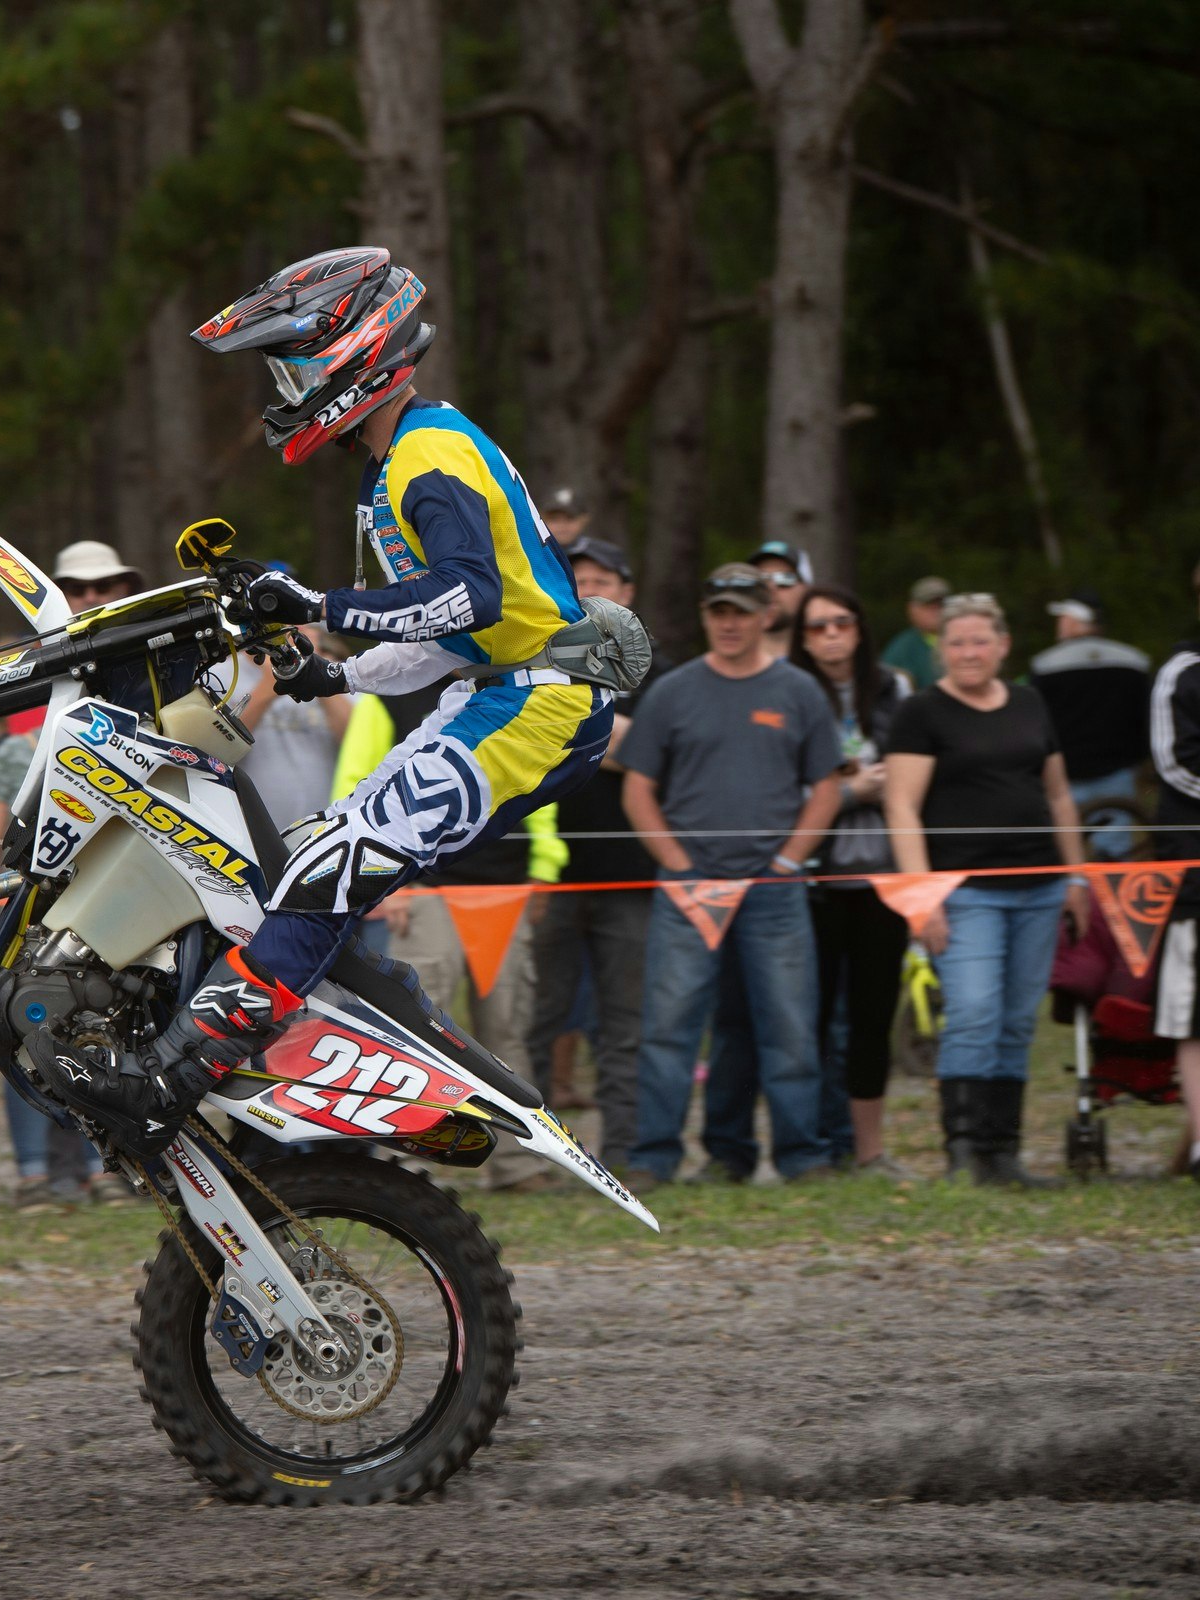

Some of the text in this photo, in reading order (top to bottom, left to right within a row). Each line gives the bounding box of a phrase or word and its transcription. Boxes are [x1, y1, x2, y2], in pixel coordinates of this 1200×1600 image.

[317, 387, 367, 427] 212
[342, 581, 472, 634] MOOSE
[402, 613, 475, 643] RACING
[212, 720, 236, 742] IMS
[170, 749, 198, 763] IMS
[50, 789, 97, 824] FMF
[56, 746, 250, 889] COASTAL
[165, 843, 252, 905] Racing
[284, 1033, 431, 1136] 212
[248, 1105, 286, 1127] HINSON
[530, 1113, 565, 1145] ACERBIS
[563, 1147, 630, 1203] MAXXIS
[204, 1221, 244, 1267] DESIGNWORKS
[216, 1221, 249, 1256] TM
